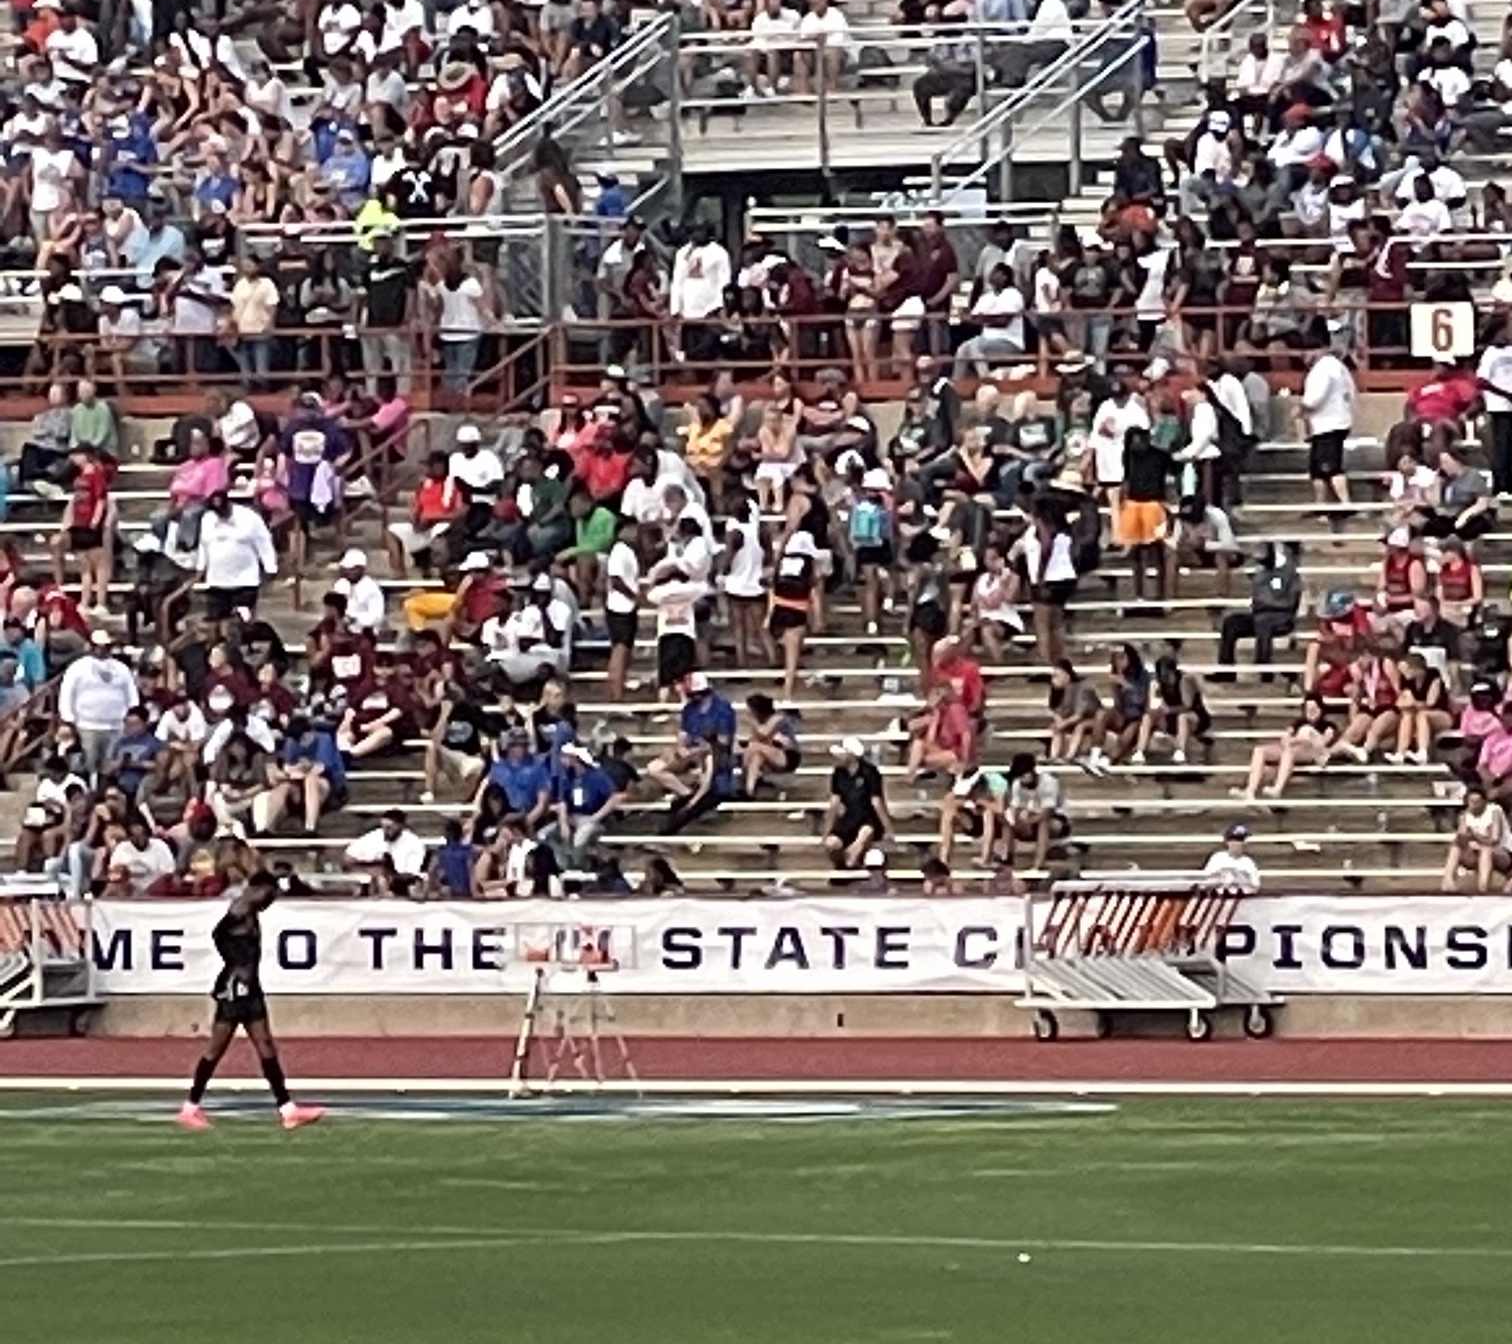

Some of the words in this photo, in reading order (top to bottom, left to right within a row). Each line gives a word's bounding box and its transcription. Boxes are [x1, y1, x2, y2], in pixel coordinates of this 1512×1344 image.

[1431, 308, 1454, 352] 6
[357, 927, 506, 971] THE
[661, 926, 911, 970] STATE
